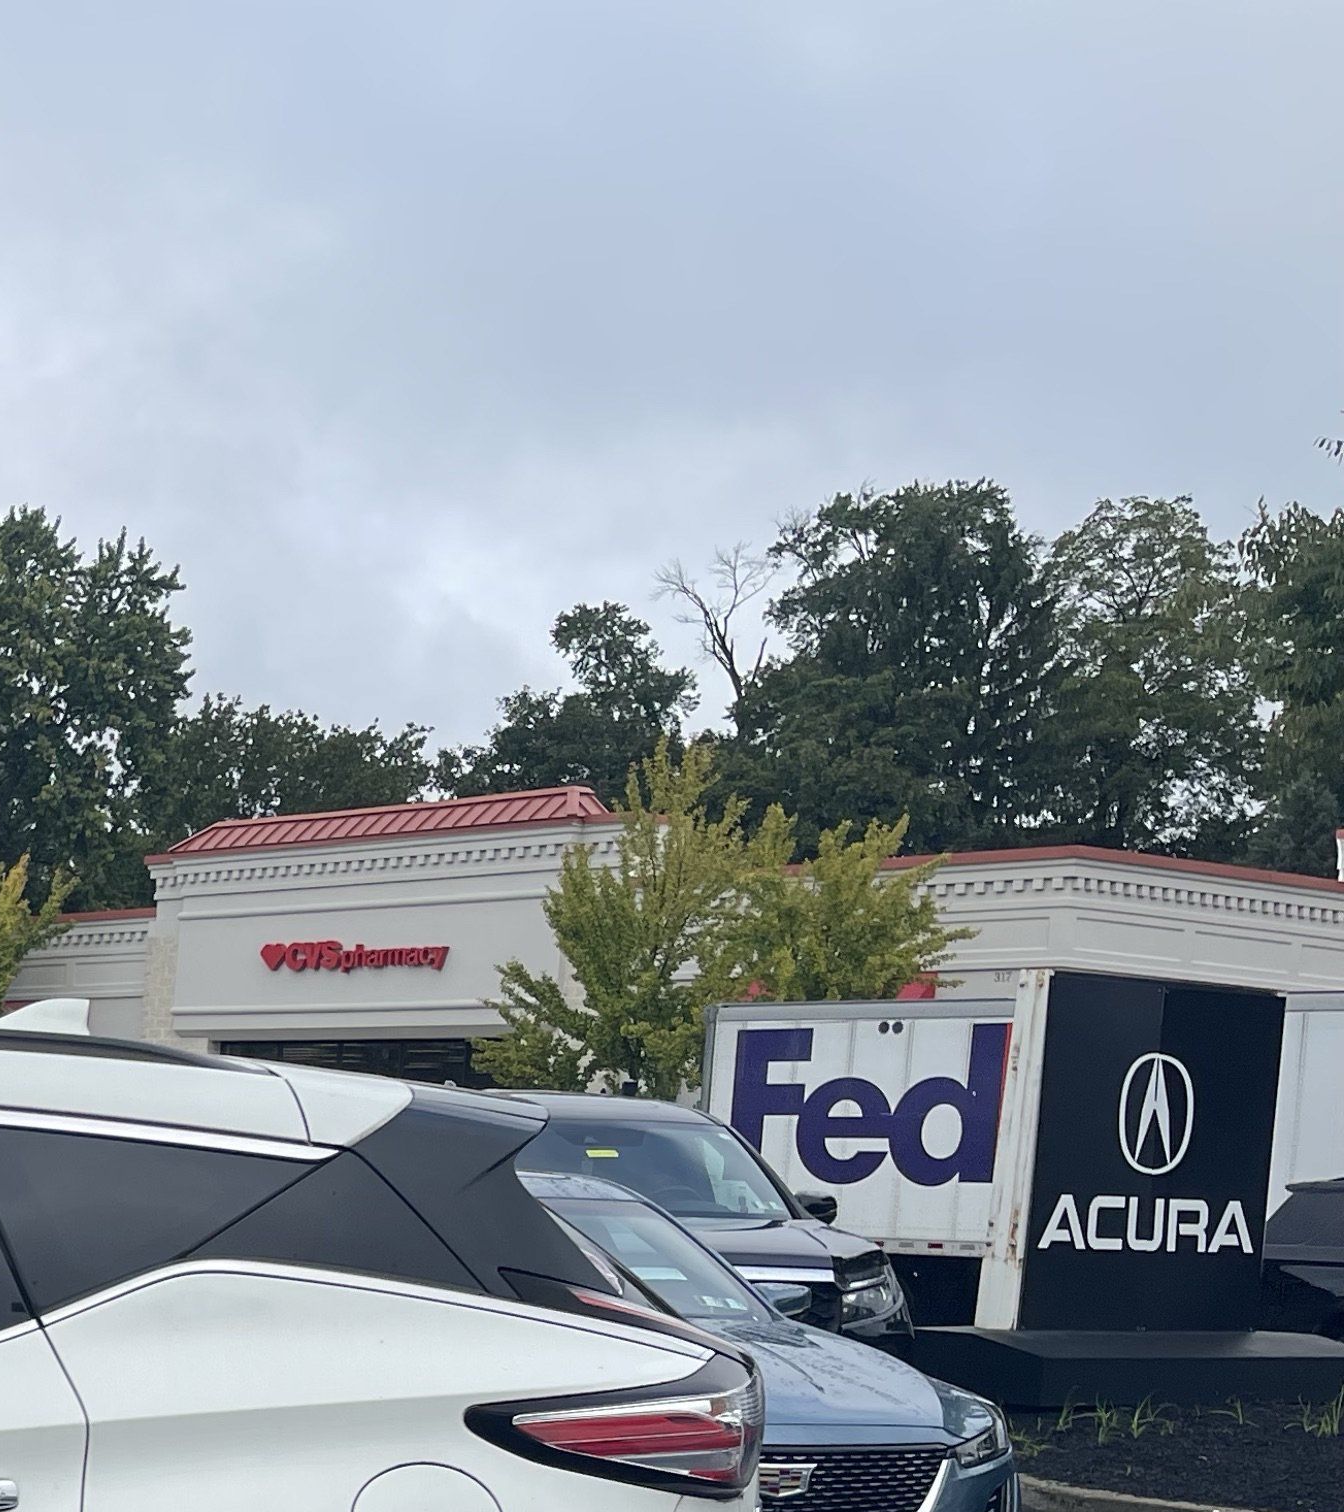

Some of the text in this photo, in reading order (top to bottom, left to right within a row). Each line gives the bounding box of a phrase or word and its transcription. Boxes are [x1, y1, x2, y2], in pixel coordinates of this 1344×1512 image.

[285, 940, 450, 974] CVS pharmacy
[730, 1022, 1011, 1187] Fed
[1037, 1193, 1255, 1255] ACURA
